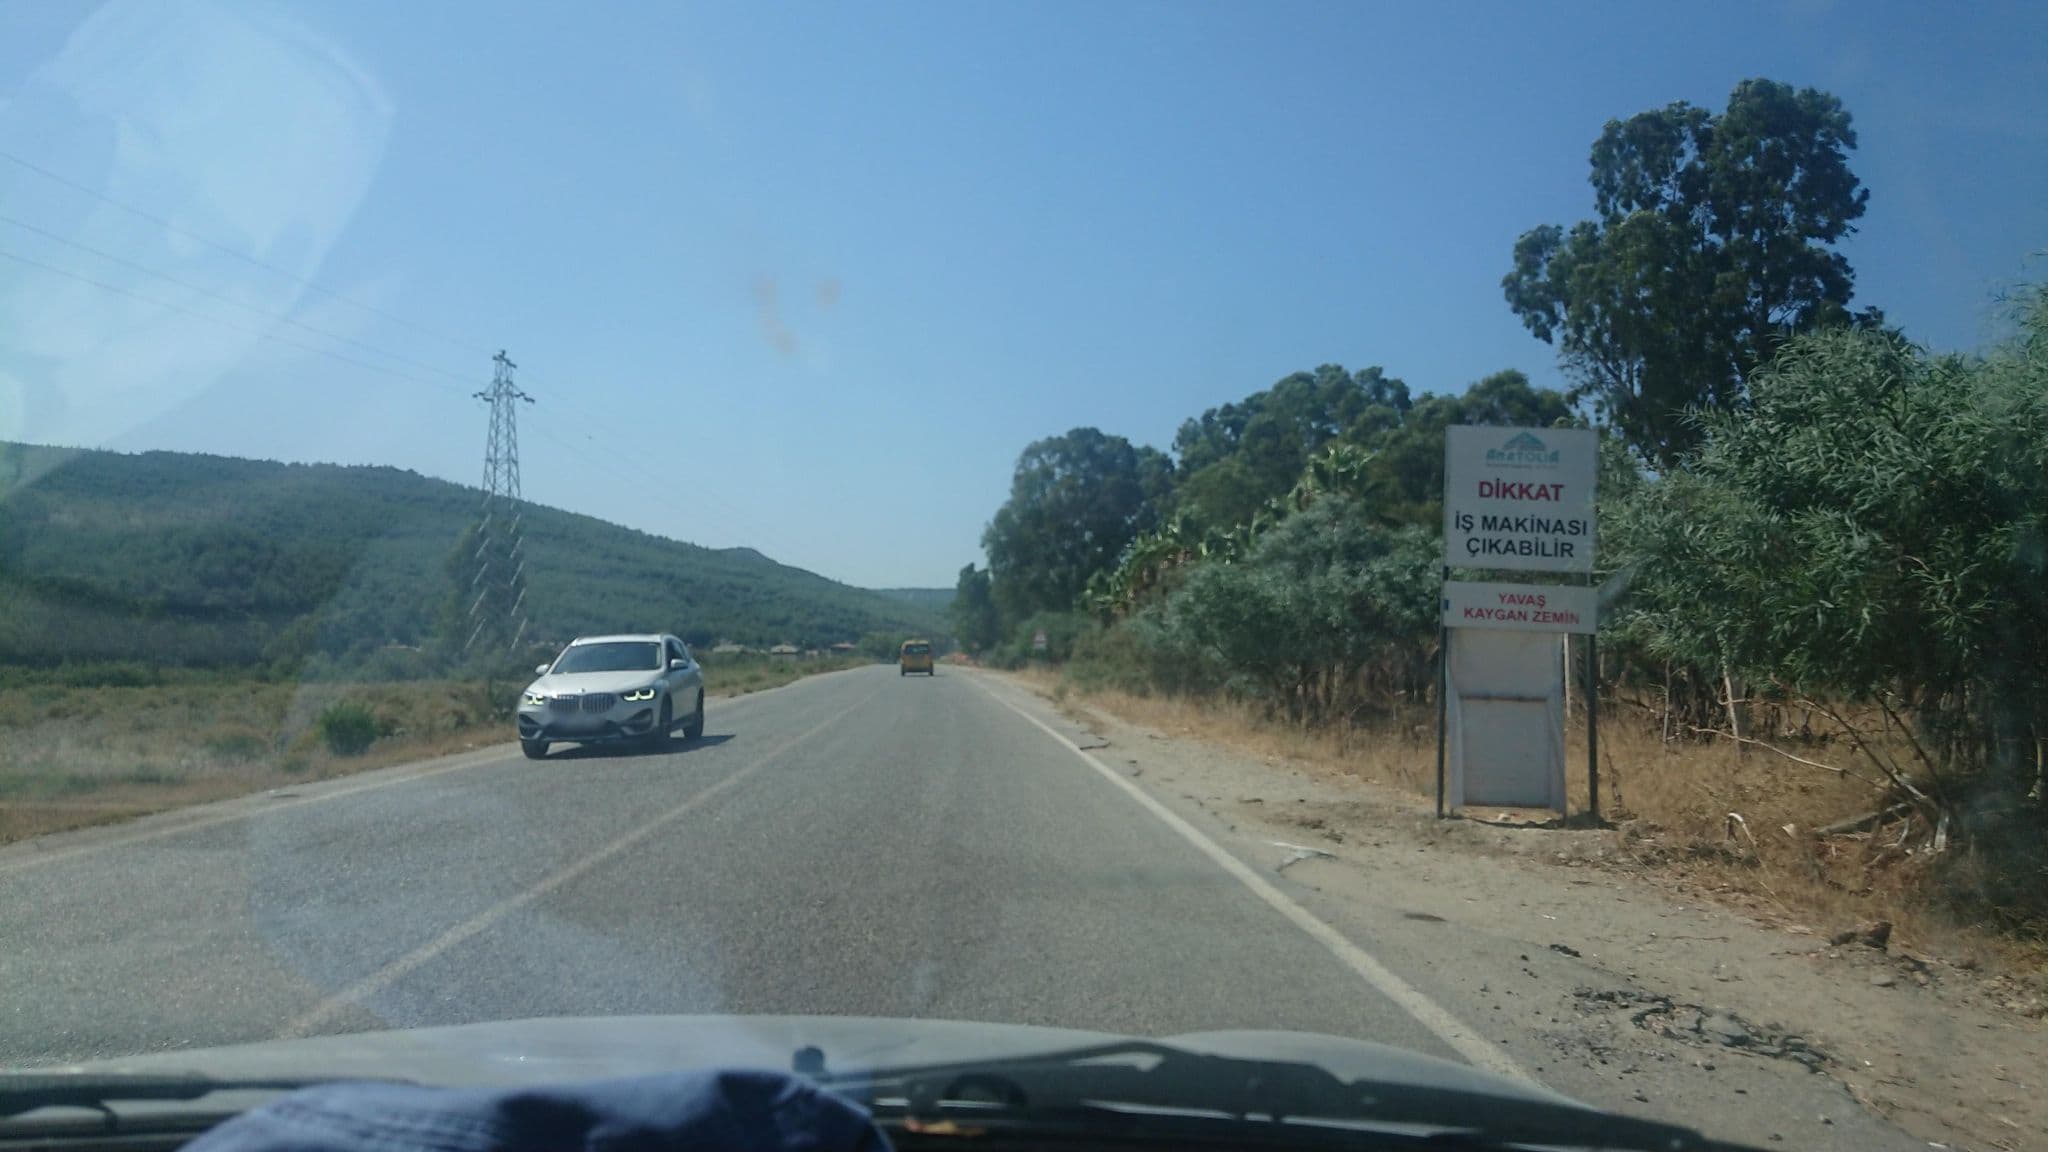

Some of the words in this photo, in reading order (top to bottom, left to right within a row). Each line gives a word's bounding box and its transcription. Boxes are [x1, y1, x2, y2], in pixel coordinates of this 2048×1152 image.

[1478, 478, 1565, 502] DİKKAT
[1455, 511, 1474, 532] İŞ
[1481, 514, 1587, 536] MAKİNASI
[1466, 537, 1574, 557] ÇIKABİLİR
[1498, 592, 1546, 607] YAVAŞ
[1464, 607, 1527, 622] KAYGAN
[1532, 609, 1580, 625] ZEMİN
